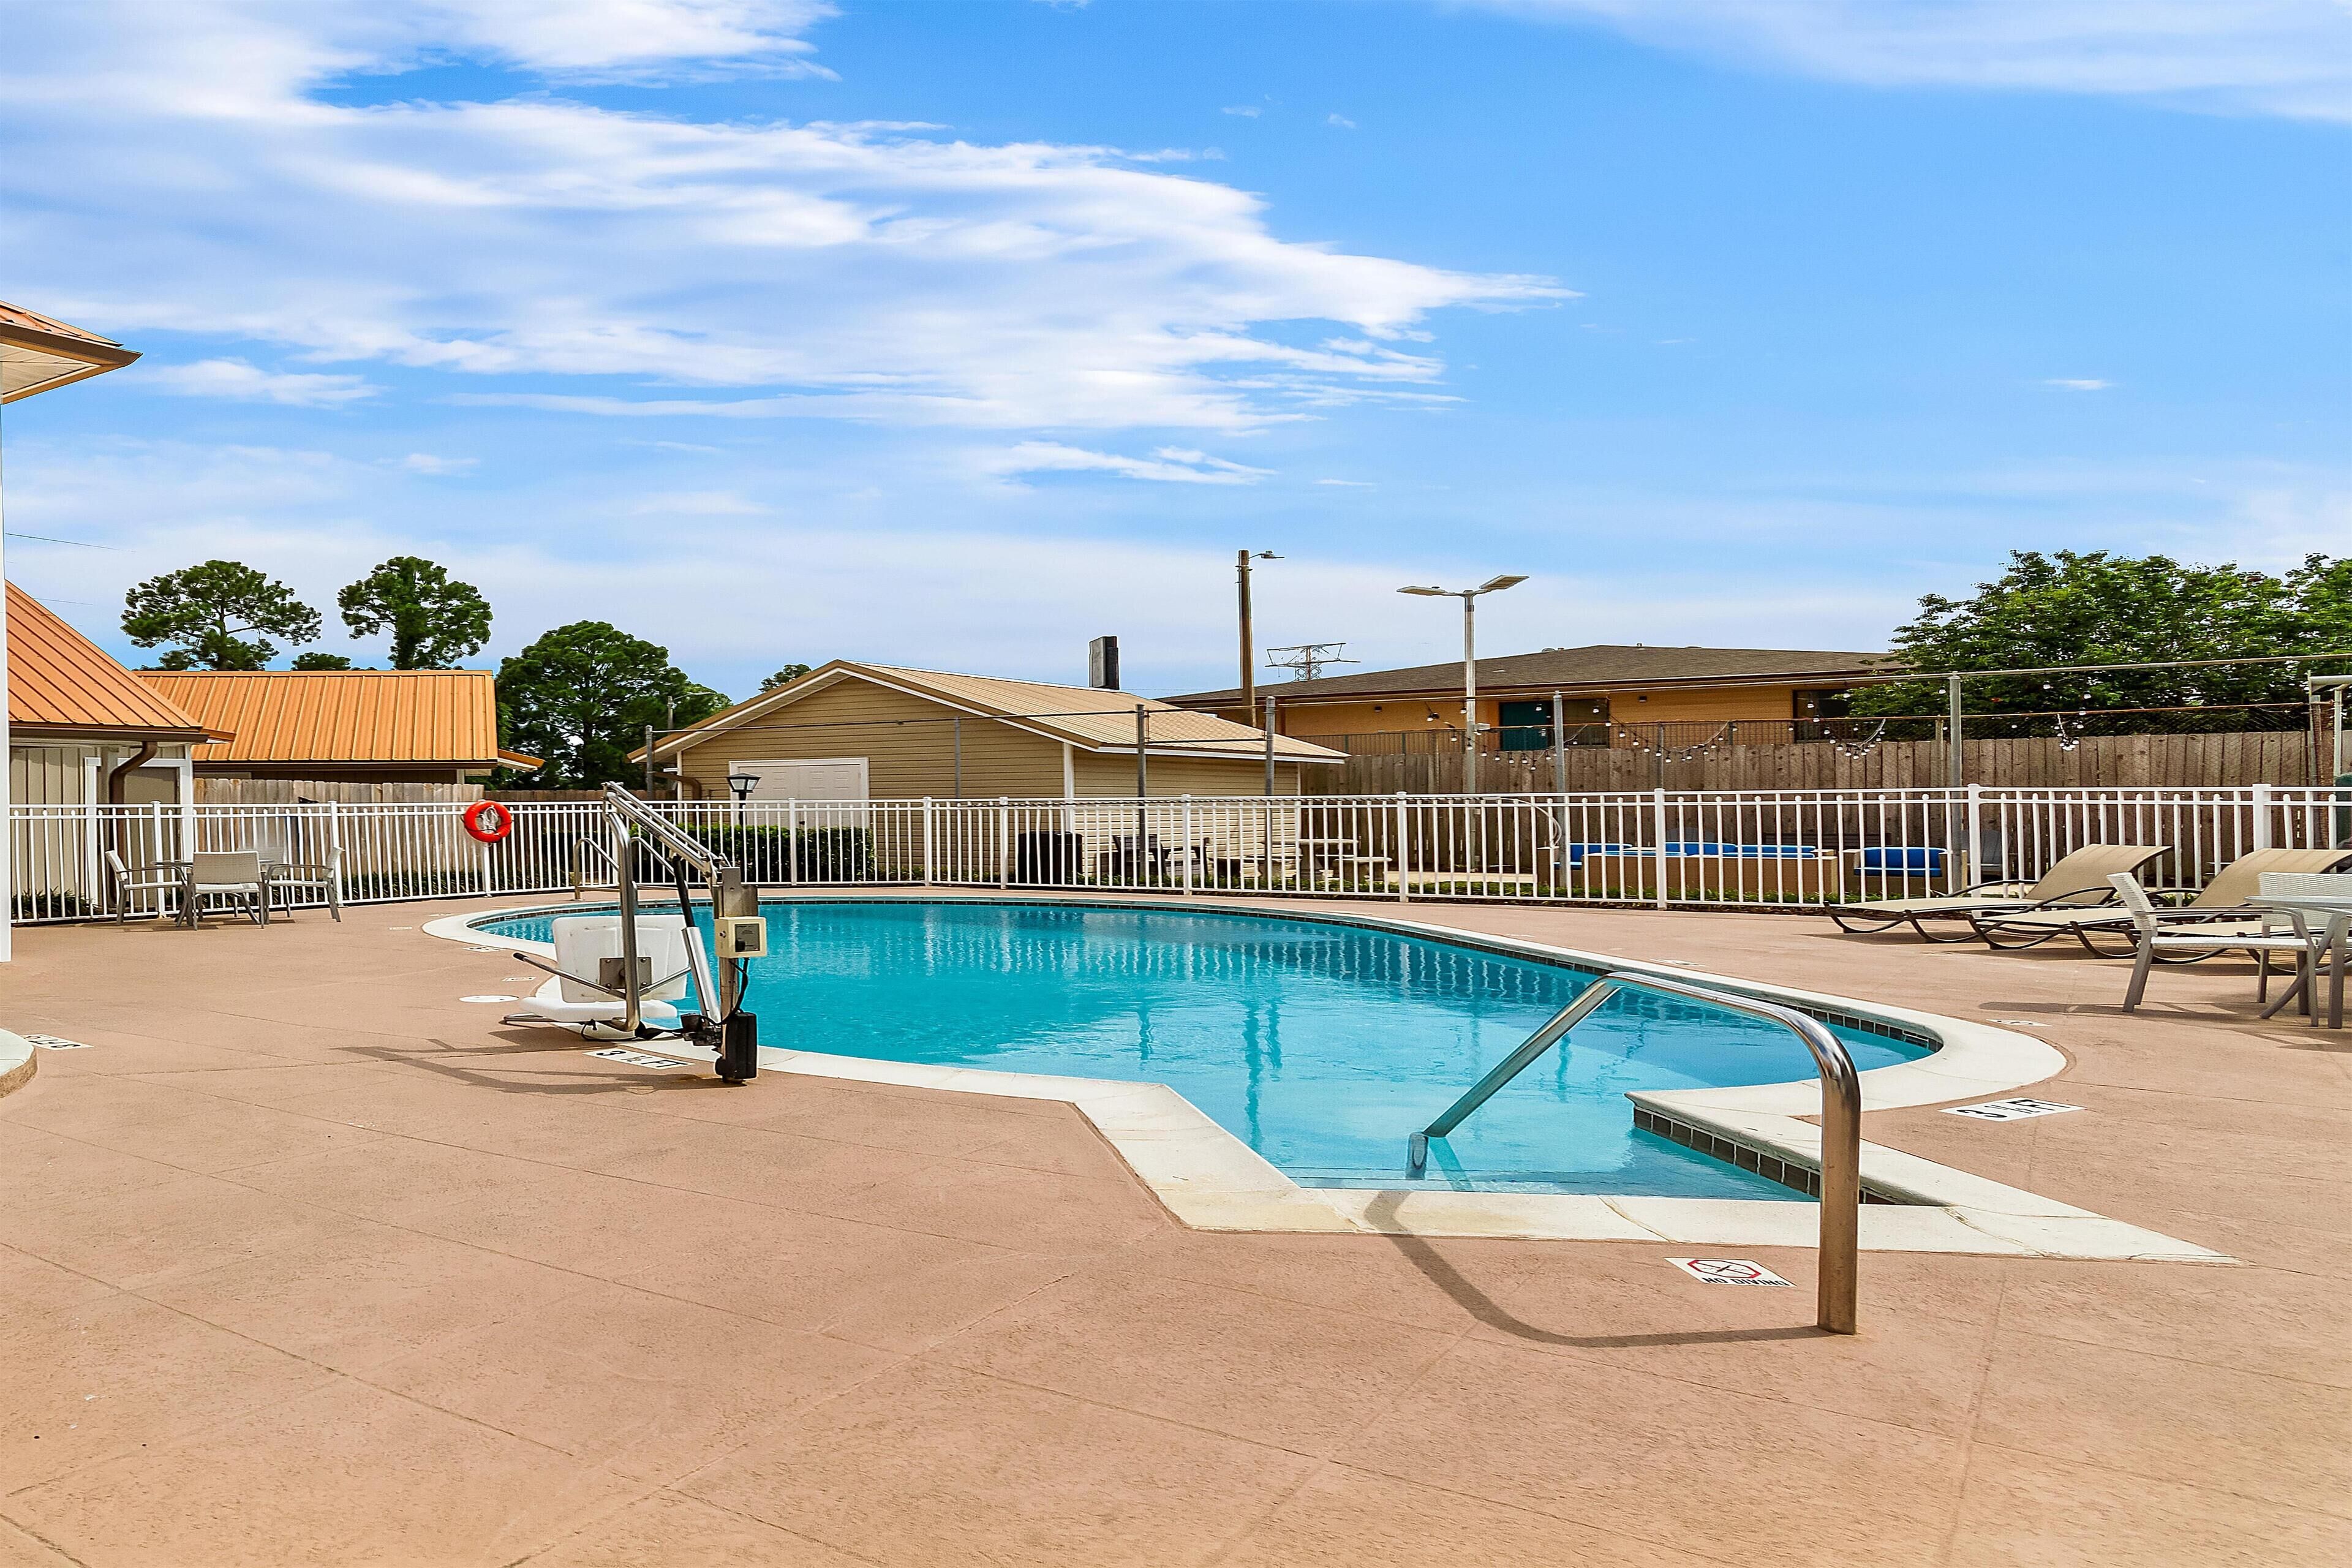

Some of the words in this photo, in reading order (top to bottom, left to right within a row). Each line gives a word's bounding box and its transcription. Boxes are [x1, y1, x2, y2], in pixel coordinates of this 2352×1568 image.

[640, 1060, 688, 1068] FT
[1956, 1109, 2008, 1118] 3
[2006, 1099, 2070, 1111] FT
